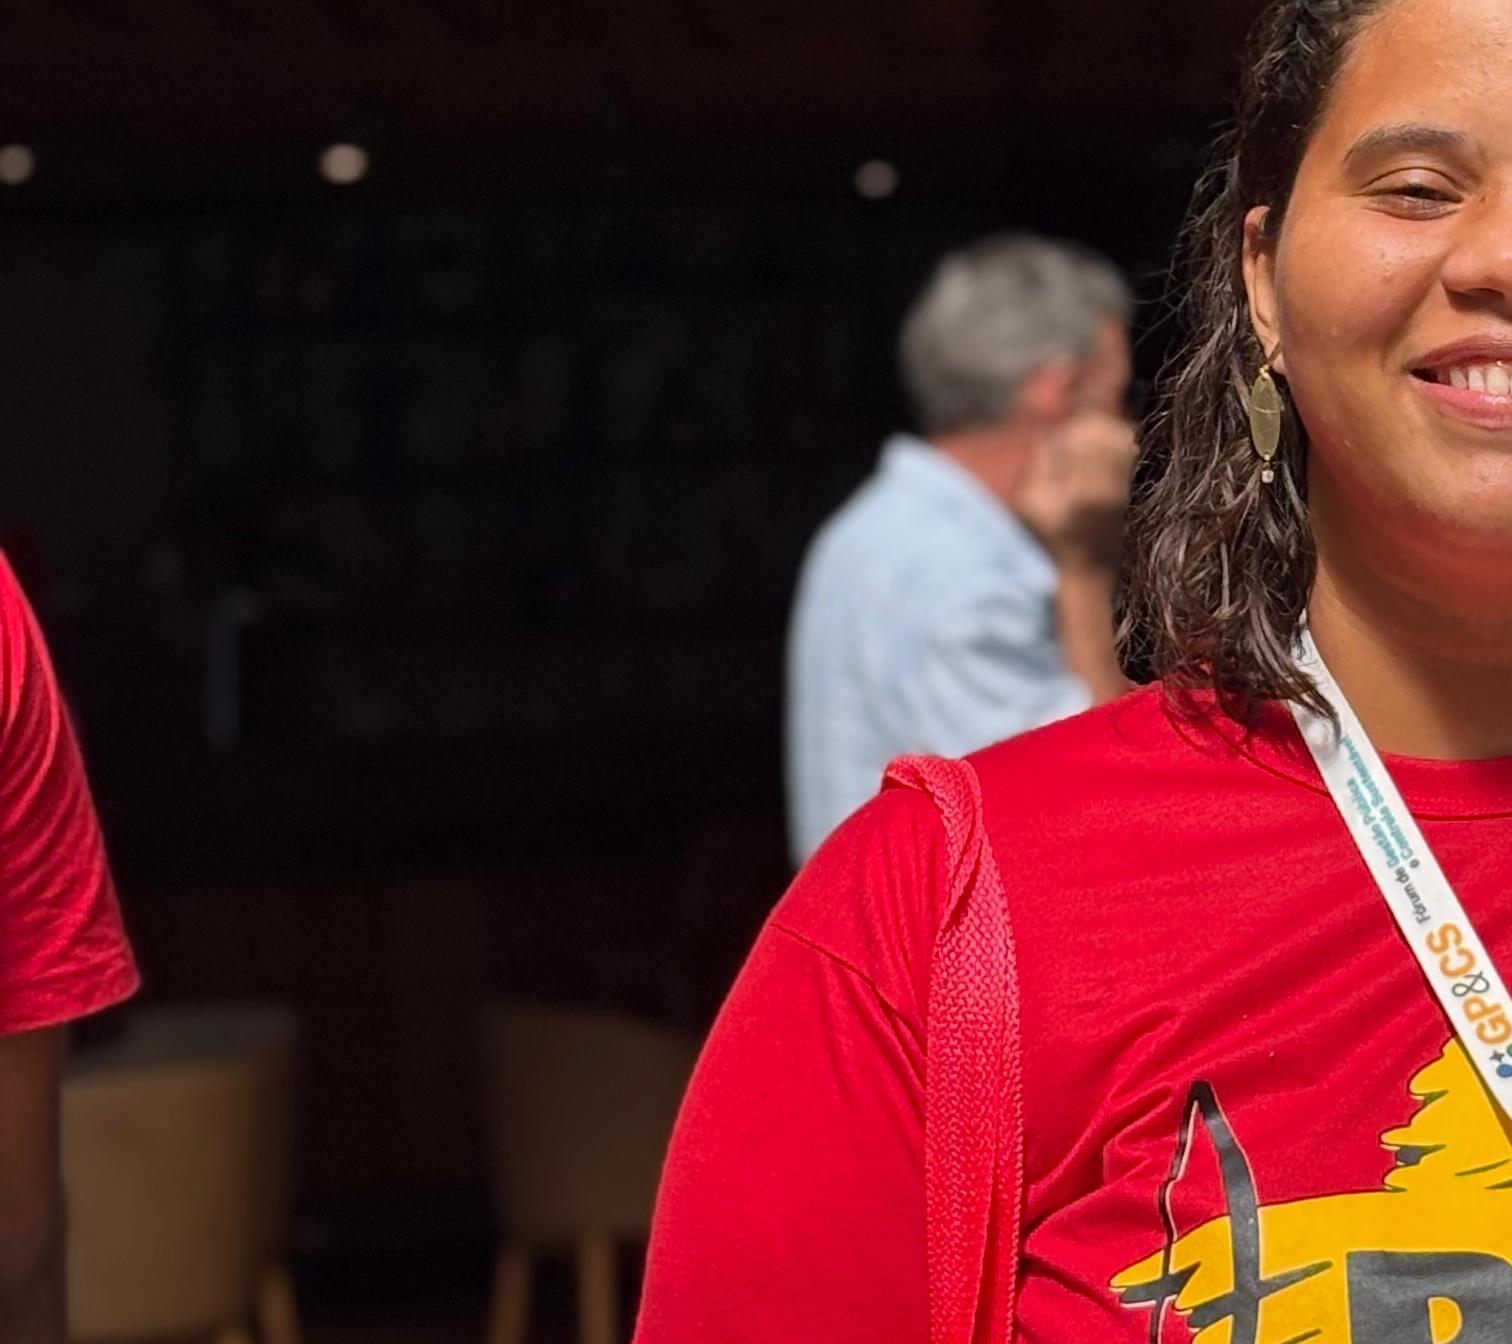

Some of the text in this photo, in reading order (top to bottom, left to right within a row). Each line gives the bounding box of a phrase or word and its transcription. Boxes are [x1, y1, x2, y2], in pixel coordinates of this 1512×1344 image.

[1395, 867, 1410, 884] de
[1404, 883, 1431, 924] Fórum
[1425, 923, 1512, 1045] GP&CS
